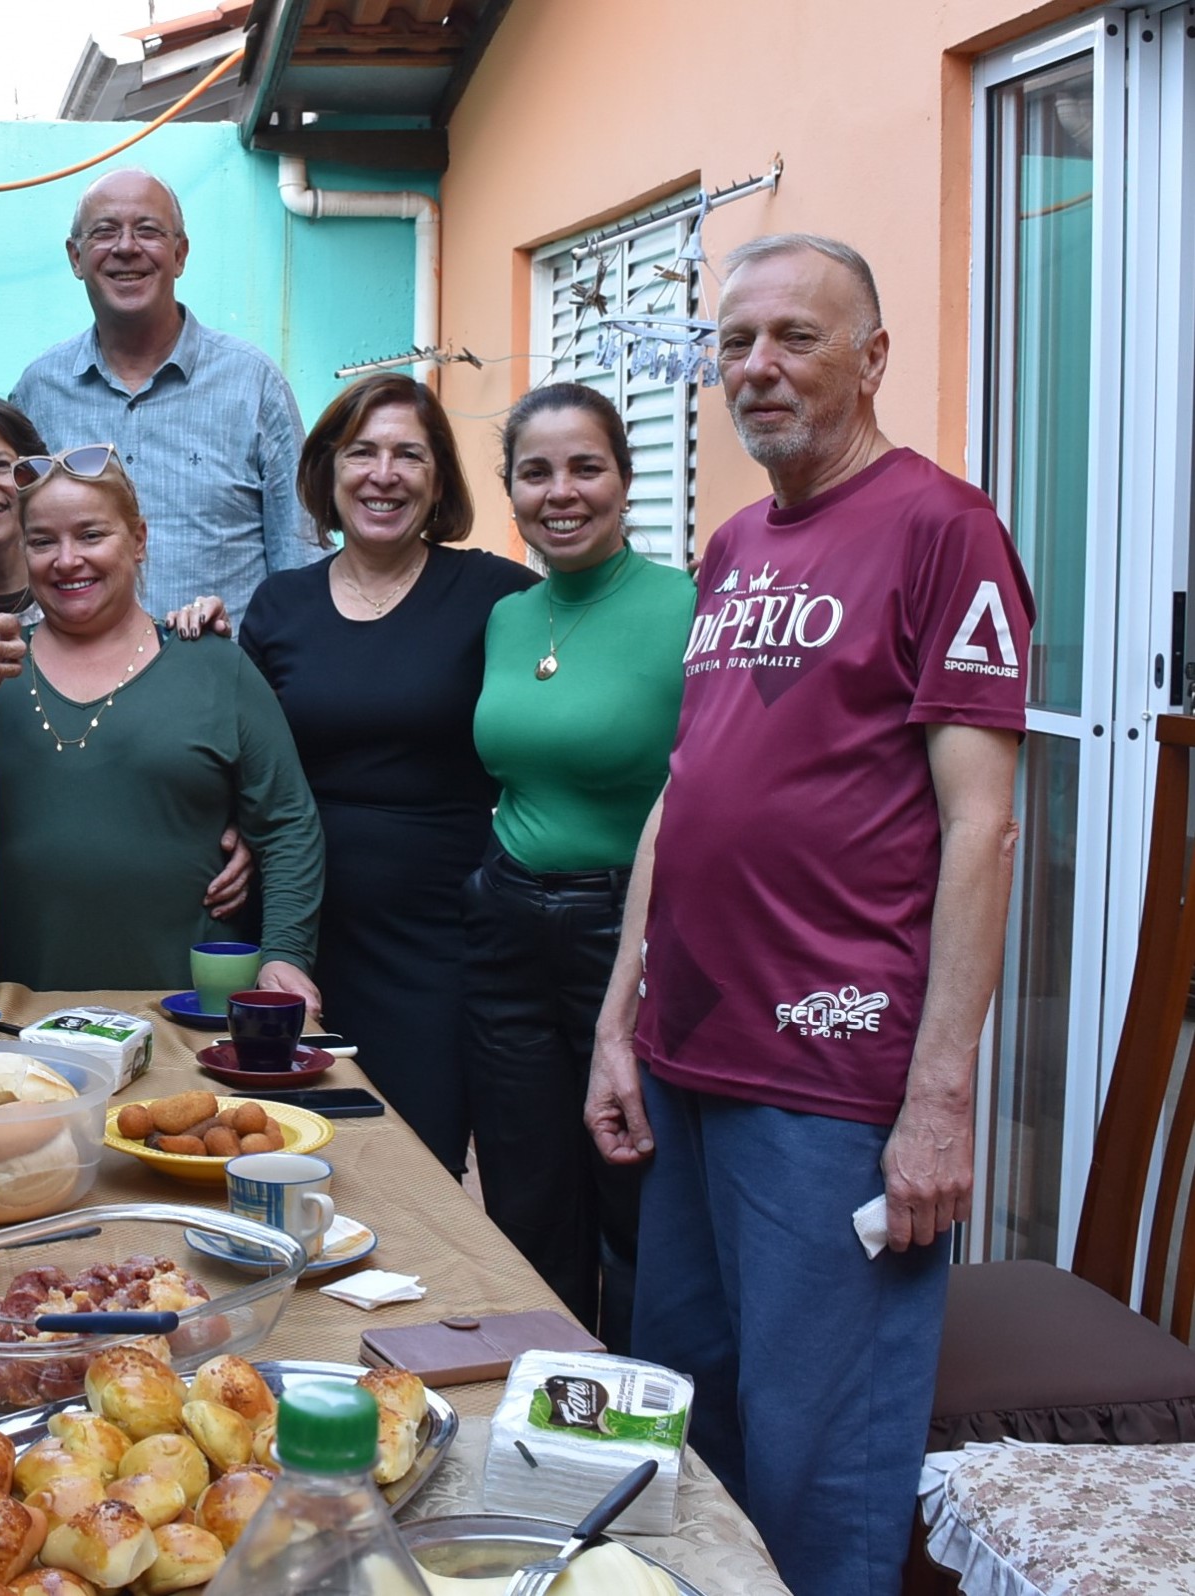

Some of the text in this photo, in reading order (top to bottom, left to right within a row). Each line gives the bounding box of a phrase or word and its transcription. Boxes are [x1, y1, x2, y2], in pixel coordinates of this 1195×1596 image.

[943, 659, 1019, 679] SPORTHOUSE
[775, 1003, 881, 1032] ECLIPSE
[799, 1027, 852, 1040] SPORT
